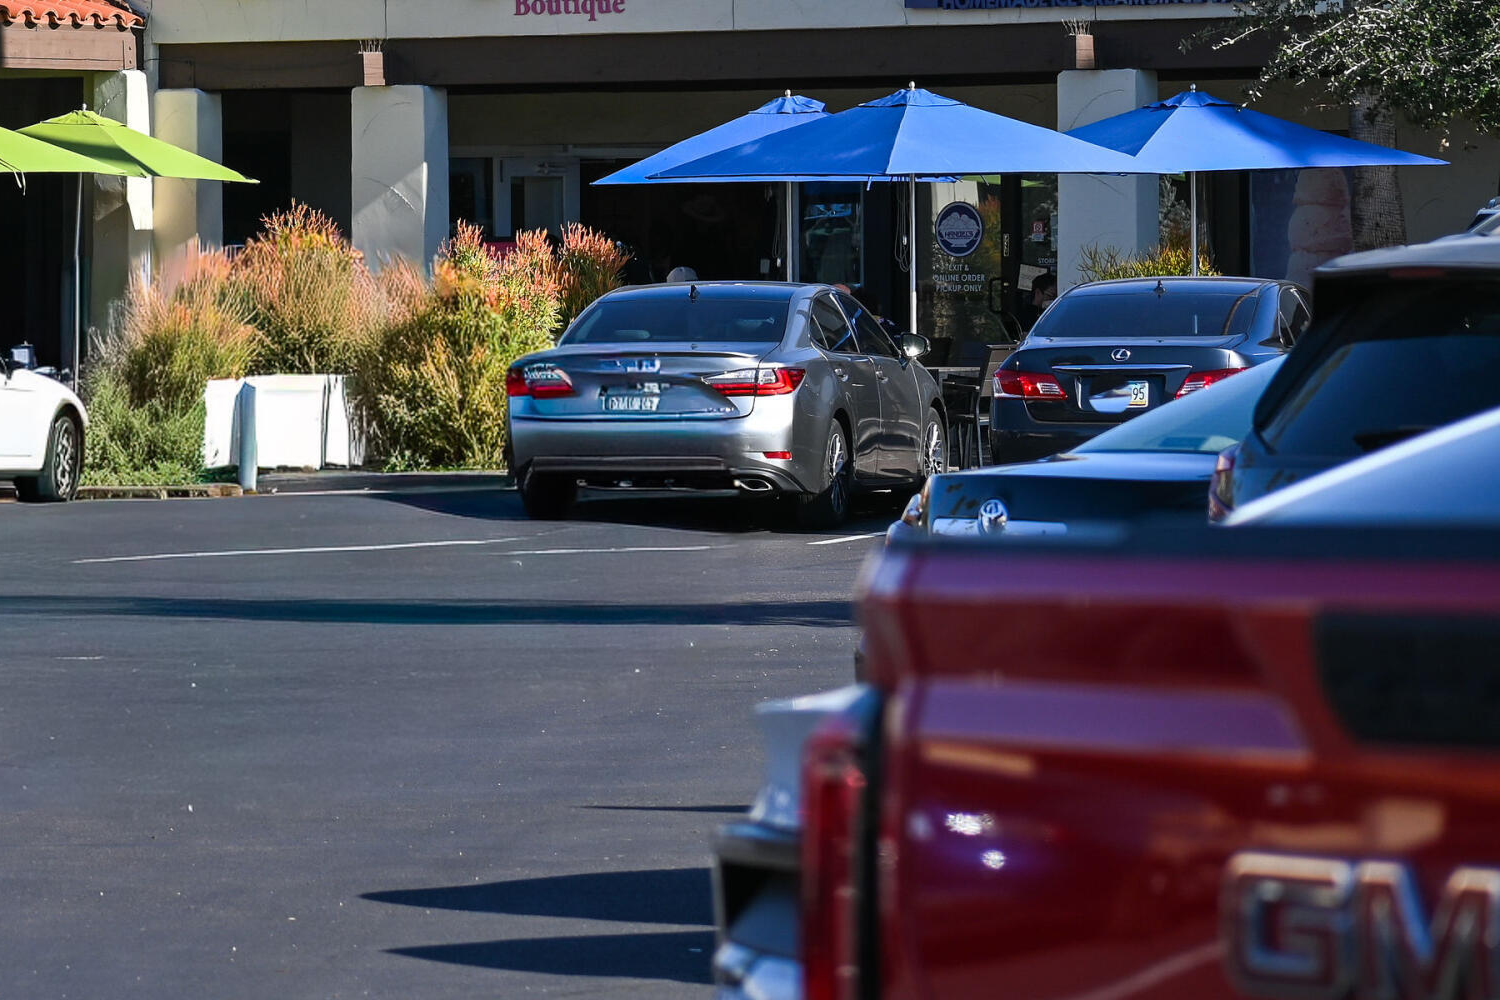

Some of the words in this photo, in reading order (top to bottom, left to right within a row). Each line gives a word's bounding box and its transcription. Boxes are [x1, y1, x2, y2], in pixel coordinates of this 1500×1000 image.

[933, 274, 960, 282] ONLINE
[961, 274, 985, 282] ORDER
[936, 284, 962, 292] PICKUP
[963, 284, 982, 292] ONLY
